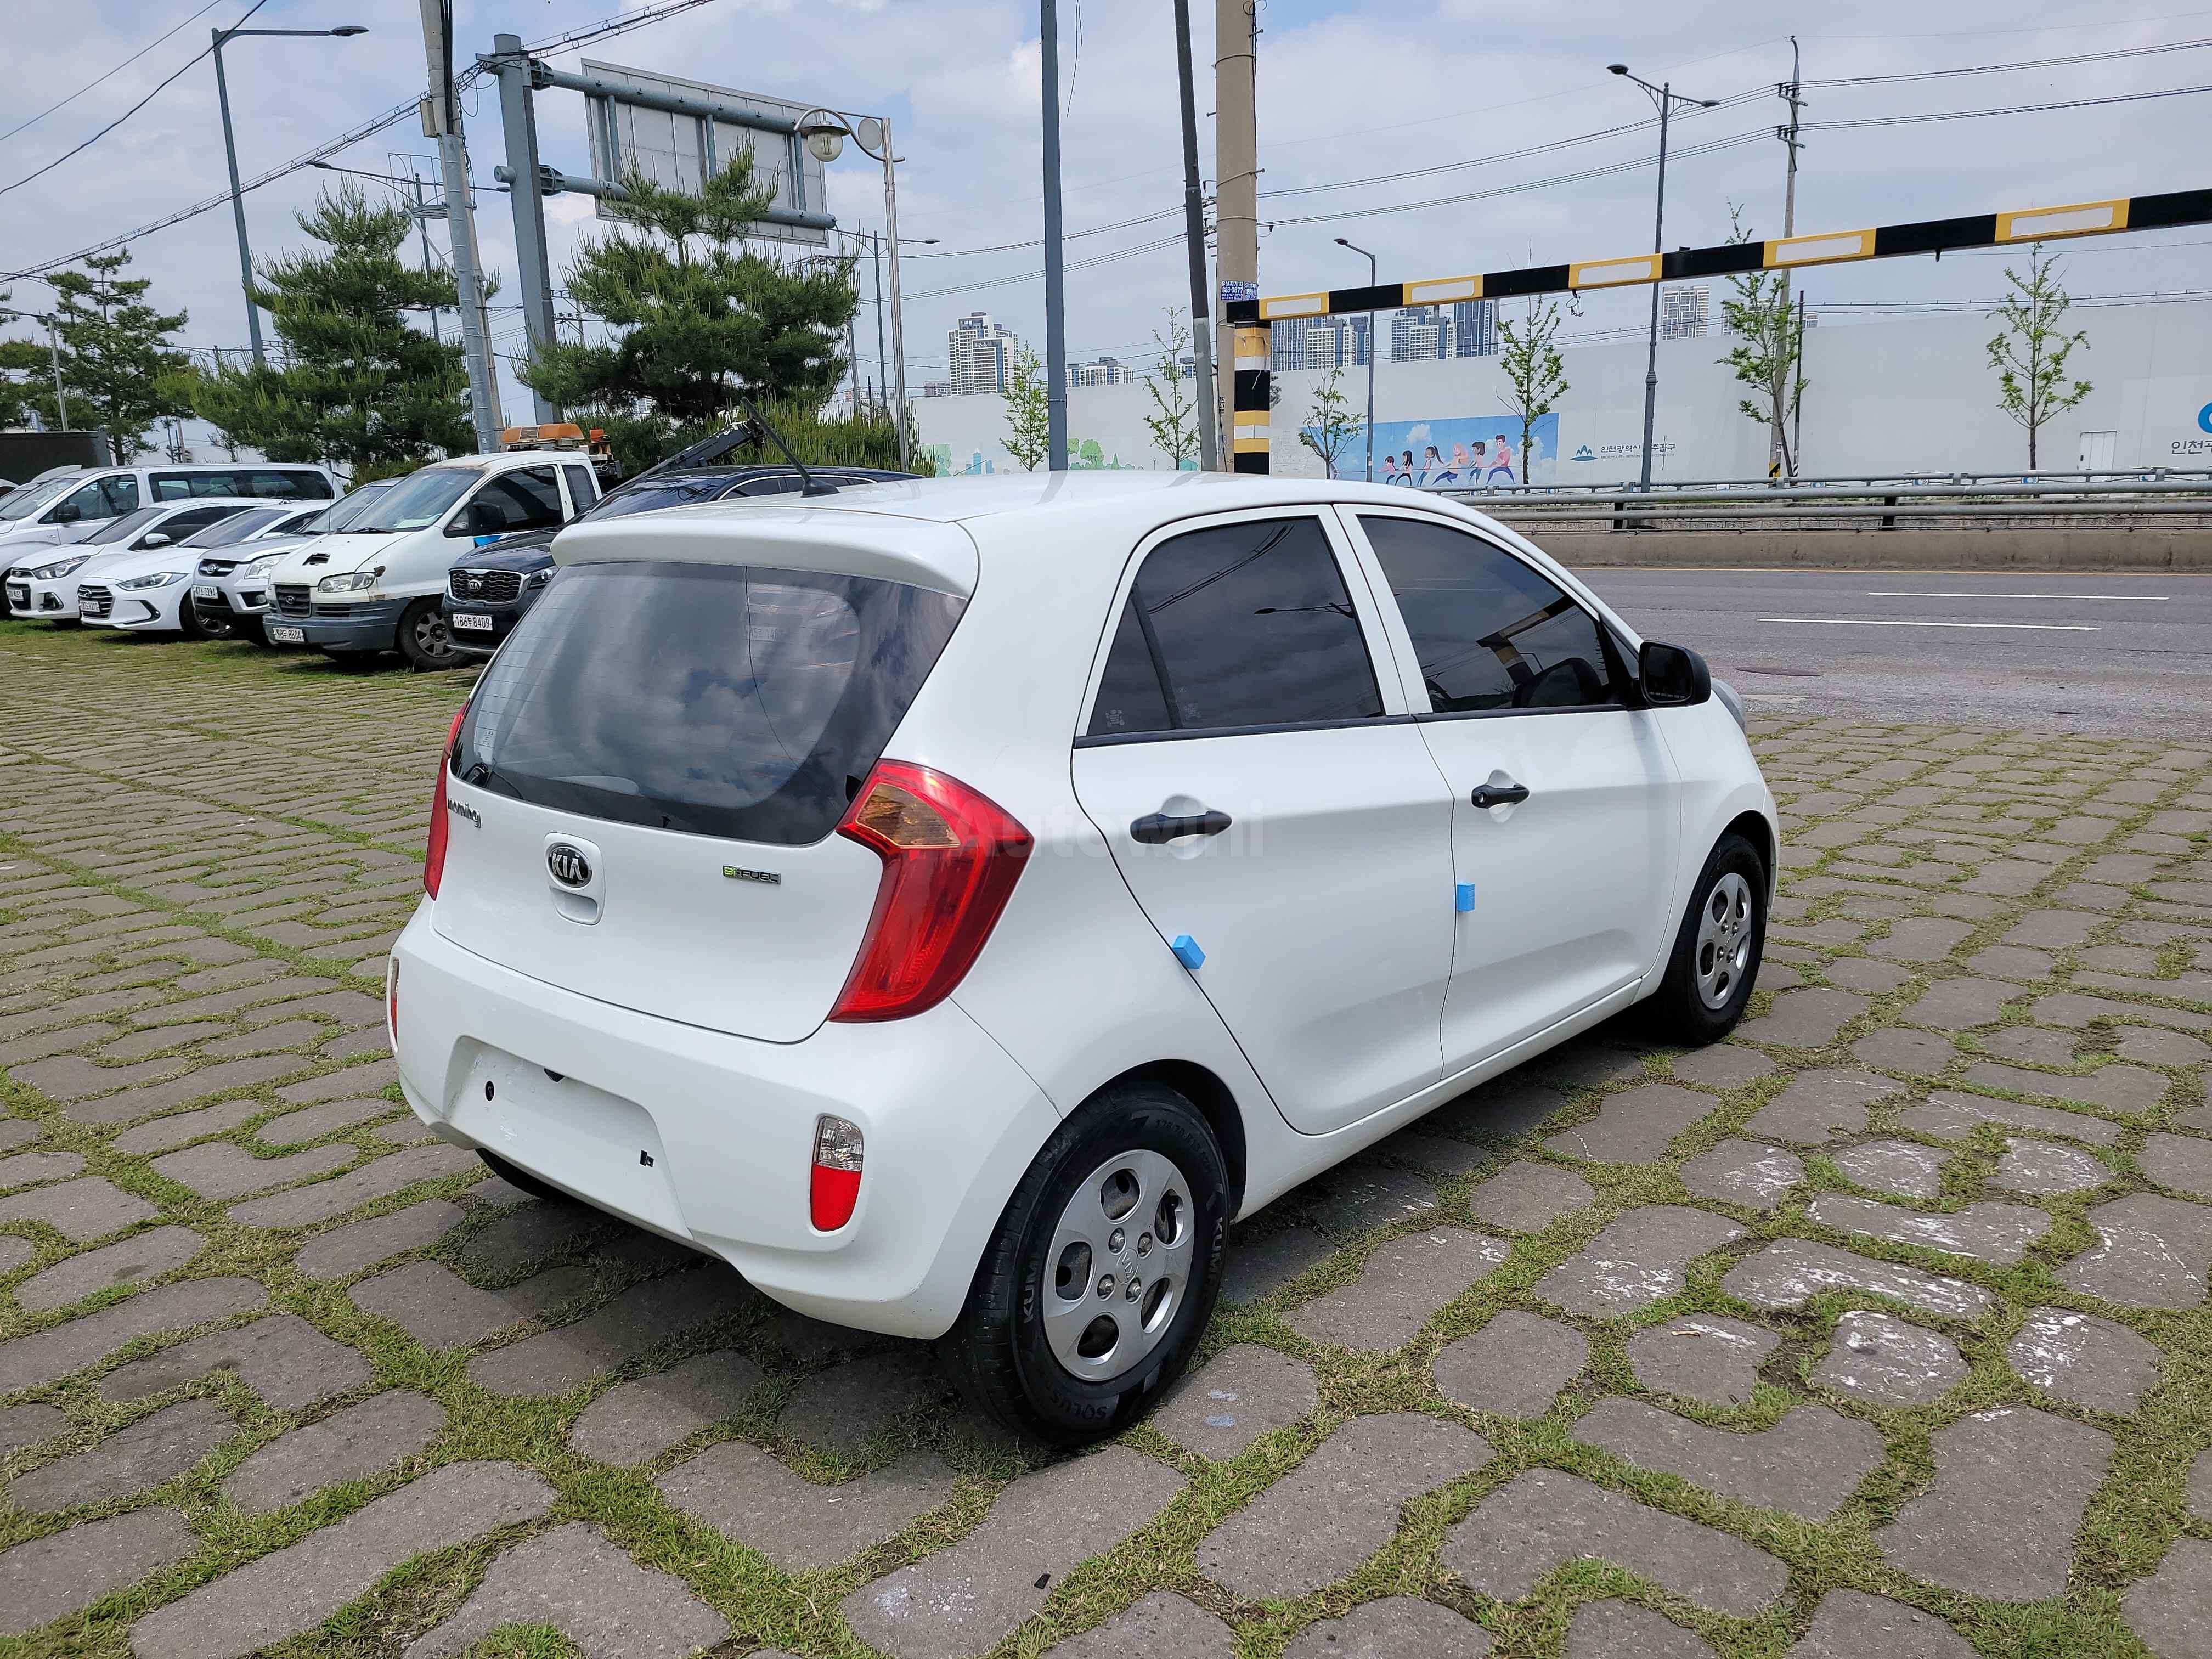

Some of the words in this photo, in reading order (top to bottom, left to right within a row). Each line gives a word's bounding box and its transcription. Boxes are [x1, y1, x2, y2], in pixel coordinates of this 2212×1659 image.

[1601, 445, 1640, 453] 인천광역시
[1651, 443, 1675, 452] 추홀구
[469, 582, 479, 590] KIA
[473, 617, 490, 628] 8409
[552, 852, 584, 881] KIA
